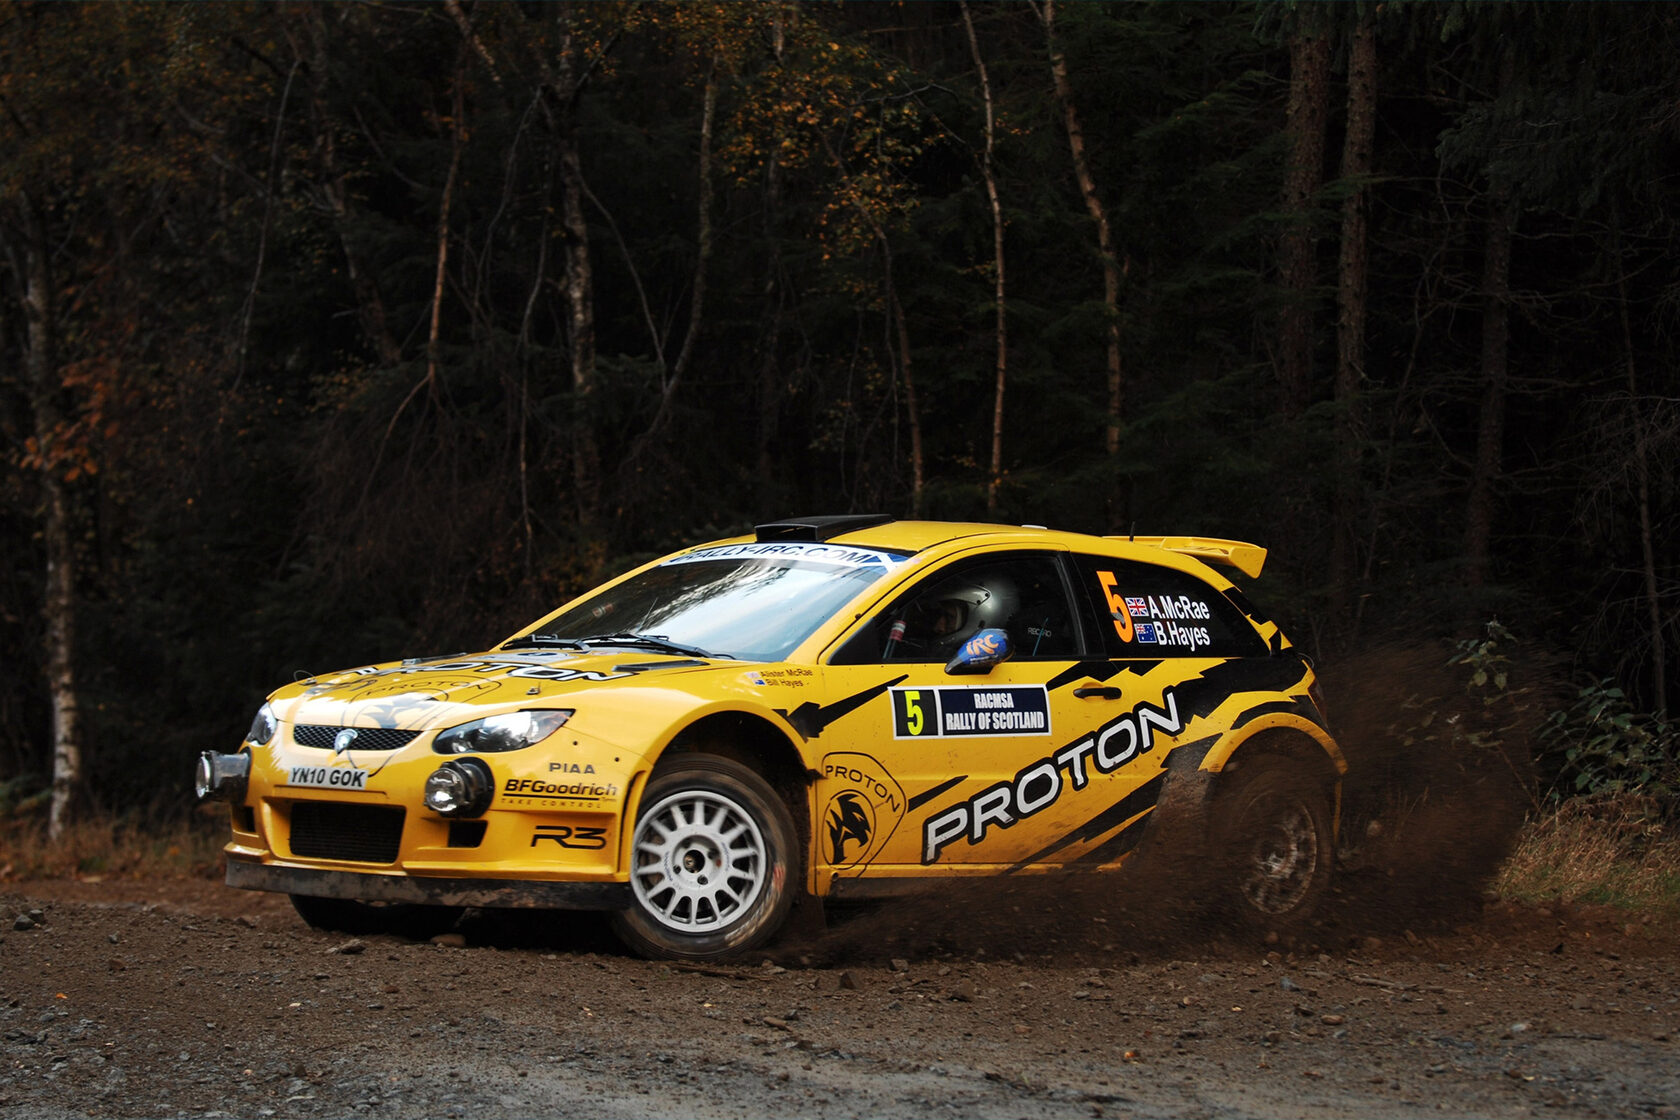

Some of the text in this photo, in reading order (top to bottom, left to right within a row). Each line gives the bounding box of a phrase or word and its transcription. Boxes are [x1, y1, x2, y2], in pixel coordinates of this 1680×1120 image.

[1096, 571, 1133, 643] 5
[1147, 595, 1210, 619] A.McRae
[1027, 627, 1052, 637] RECRO
[1153, 621, 1211, 652] B.Hayes
[966, 635, 999, 656] IRC
[785, 668, 813, 677] McRae
[365, 681, 490, 696] PROTON
[780, 679, 804, 689] Hayes
[973, 692, 1014, 709] RACMSA
[904, 690, 924, 736] 5
[945, 711, 1045, 731] RALLY OF SCOTLAND
[291, 767, 366, 787] YN10 GOK
[549, 762, 595, 775] PIAA
[926, 691, 1181, 863] PROTON
[504, 779, 617, 797] BFGoodrich
[825, 765, 901, 813] PROTON
[502, 798, 601, 809] TAKE CONTROL
[530, 825, 607, 850] R3
